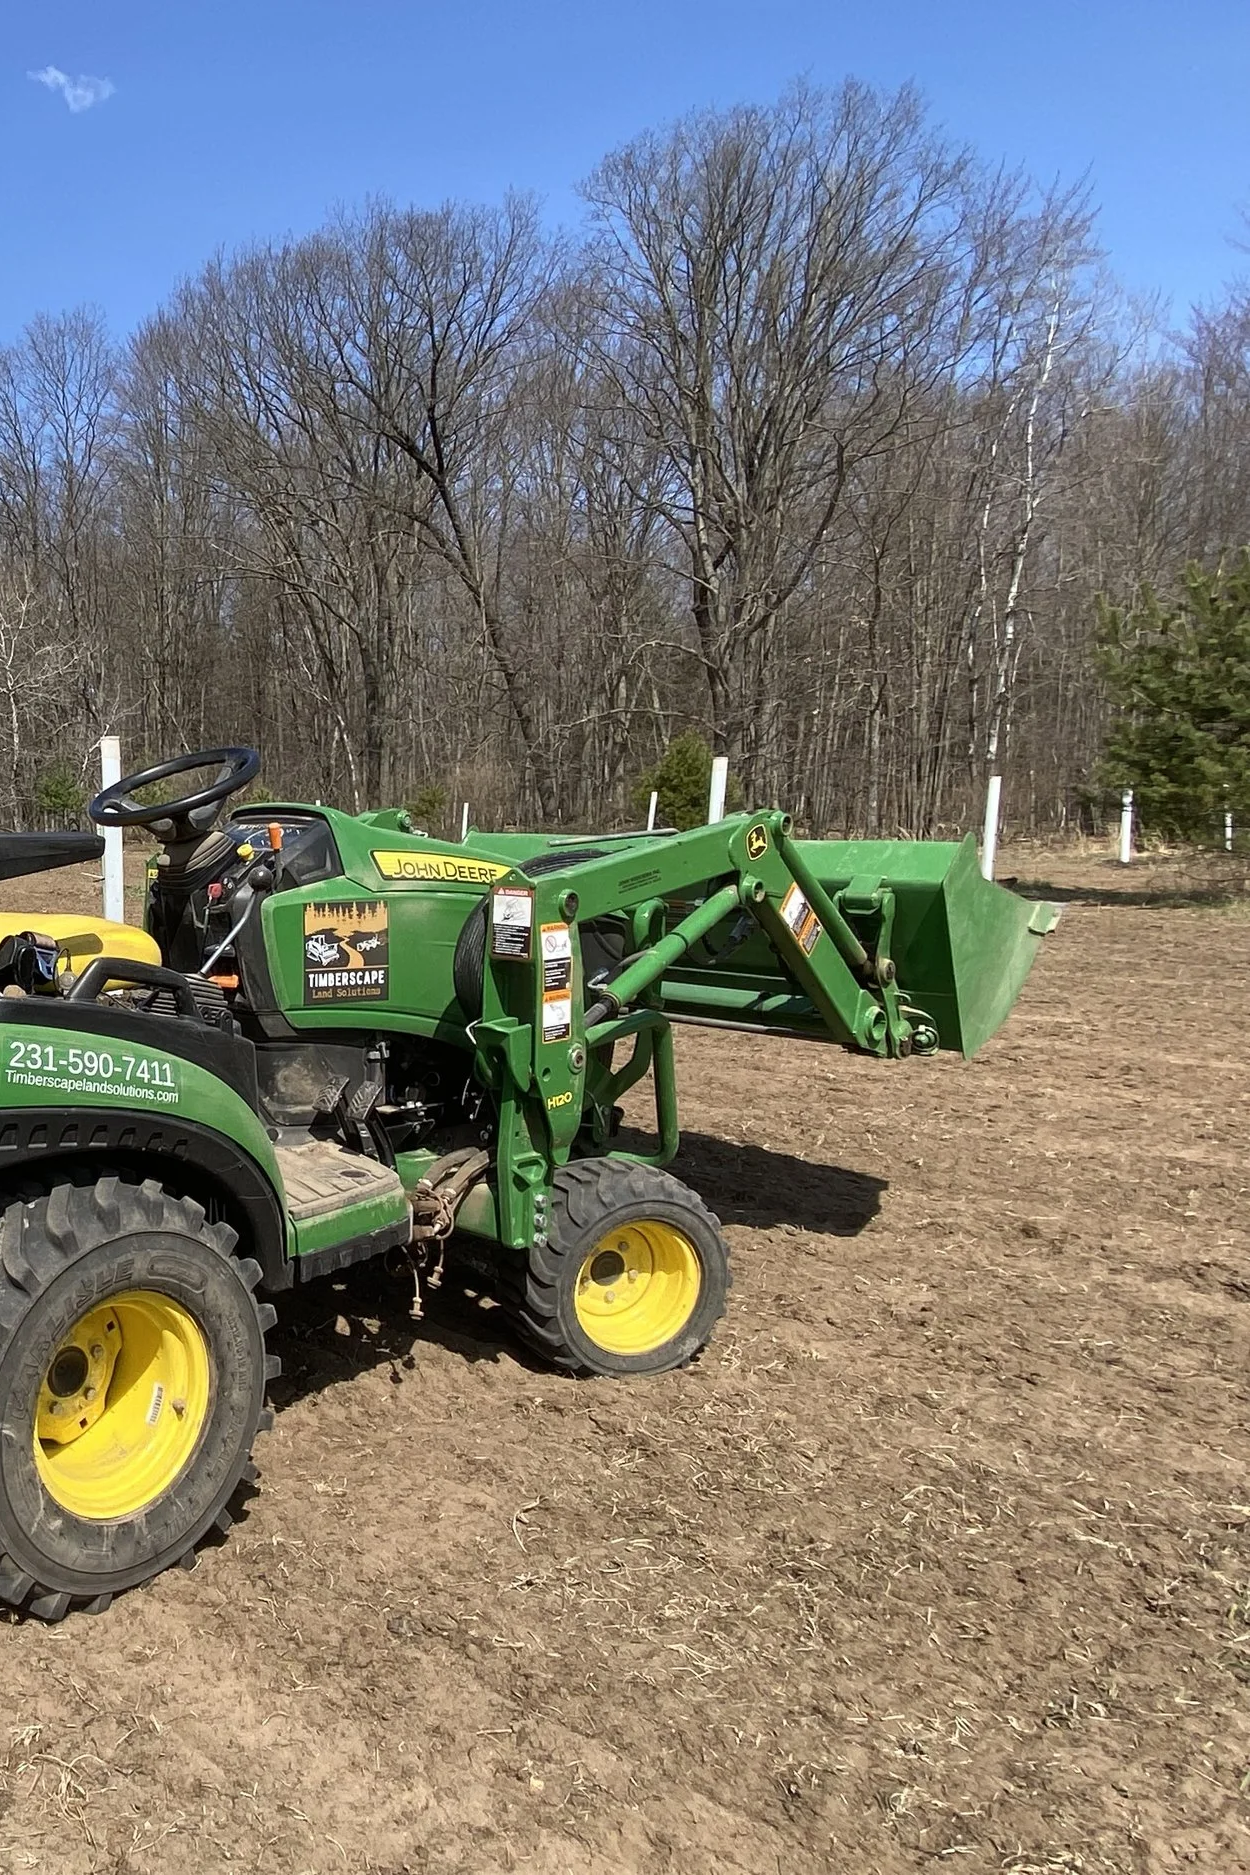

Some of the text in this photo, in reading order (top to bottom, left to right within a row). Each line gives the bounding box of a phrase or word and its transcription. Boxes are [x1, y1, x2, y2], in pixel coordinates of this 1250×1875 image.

[394, 859, 497, 880] JOHN DEERE
[308, 970, 385, 988] TIMBERSCAPE
[312, 987, 381, 999] Land Solutions
[9, 1041, 175, 1088] 231-590-7411
[5, 1069, 179, 1103] Timberscapelandsolutions.com
